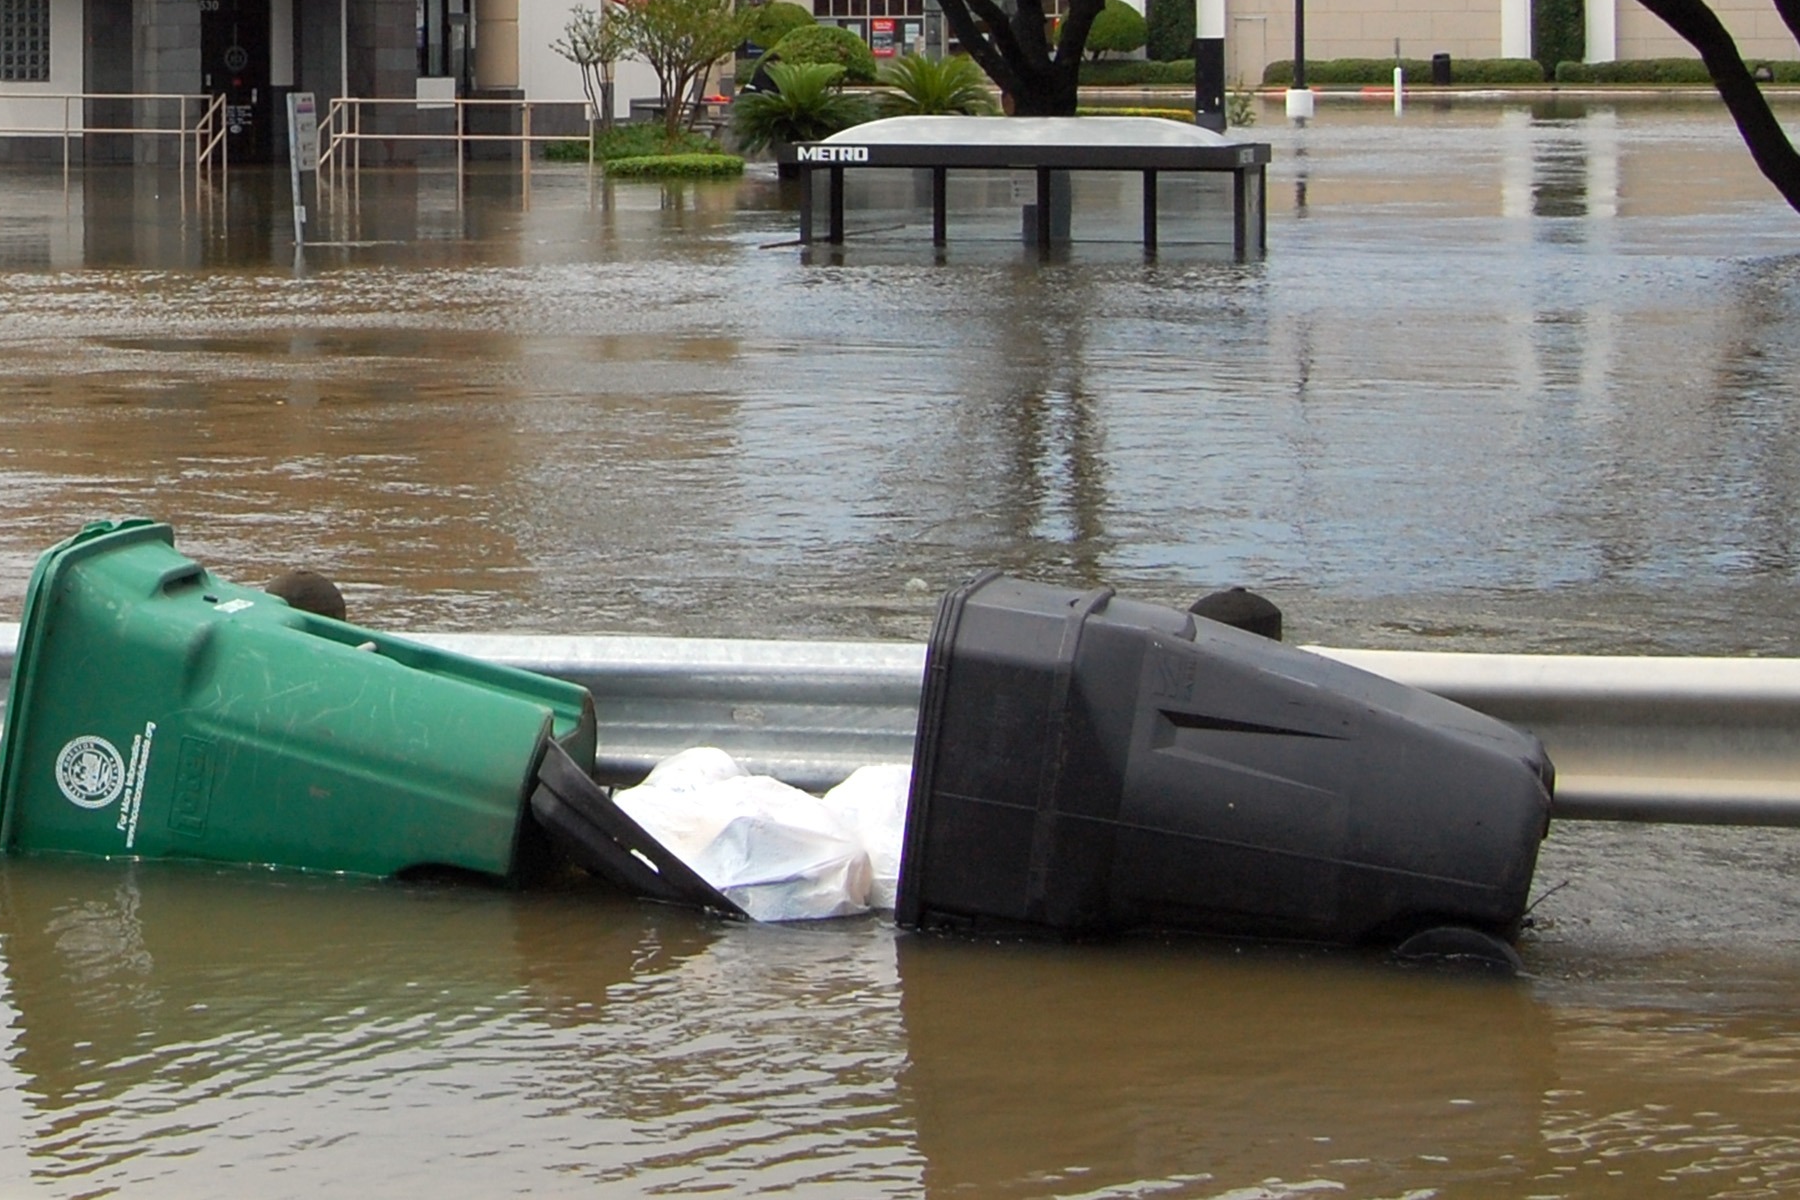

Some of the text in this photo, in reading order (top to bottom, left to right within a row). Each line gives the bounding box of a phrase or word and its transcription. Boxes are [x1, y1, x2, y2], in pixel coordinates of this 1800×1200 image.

[797, 146, 869, 161] METRO
[117, 734, 142, 831] For More Information
